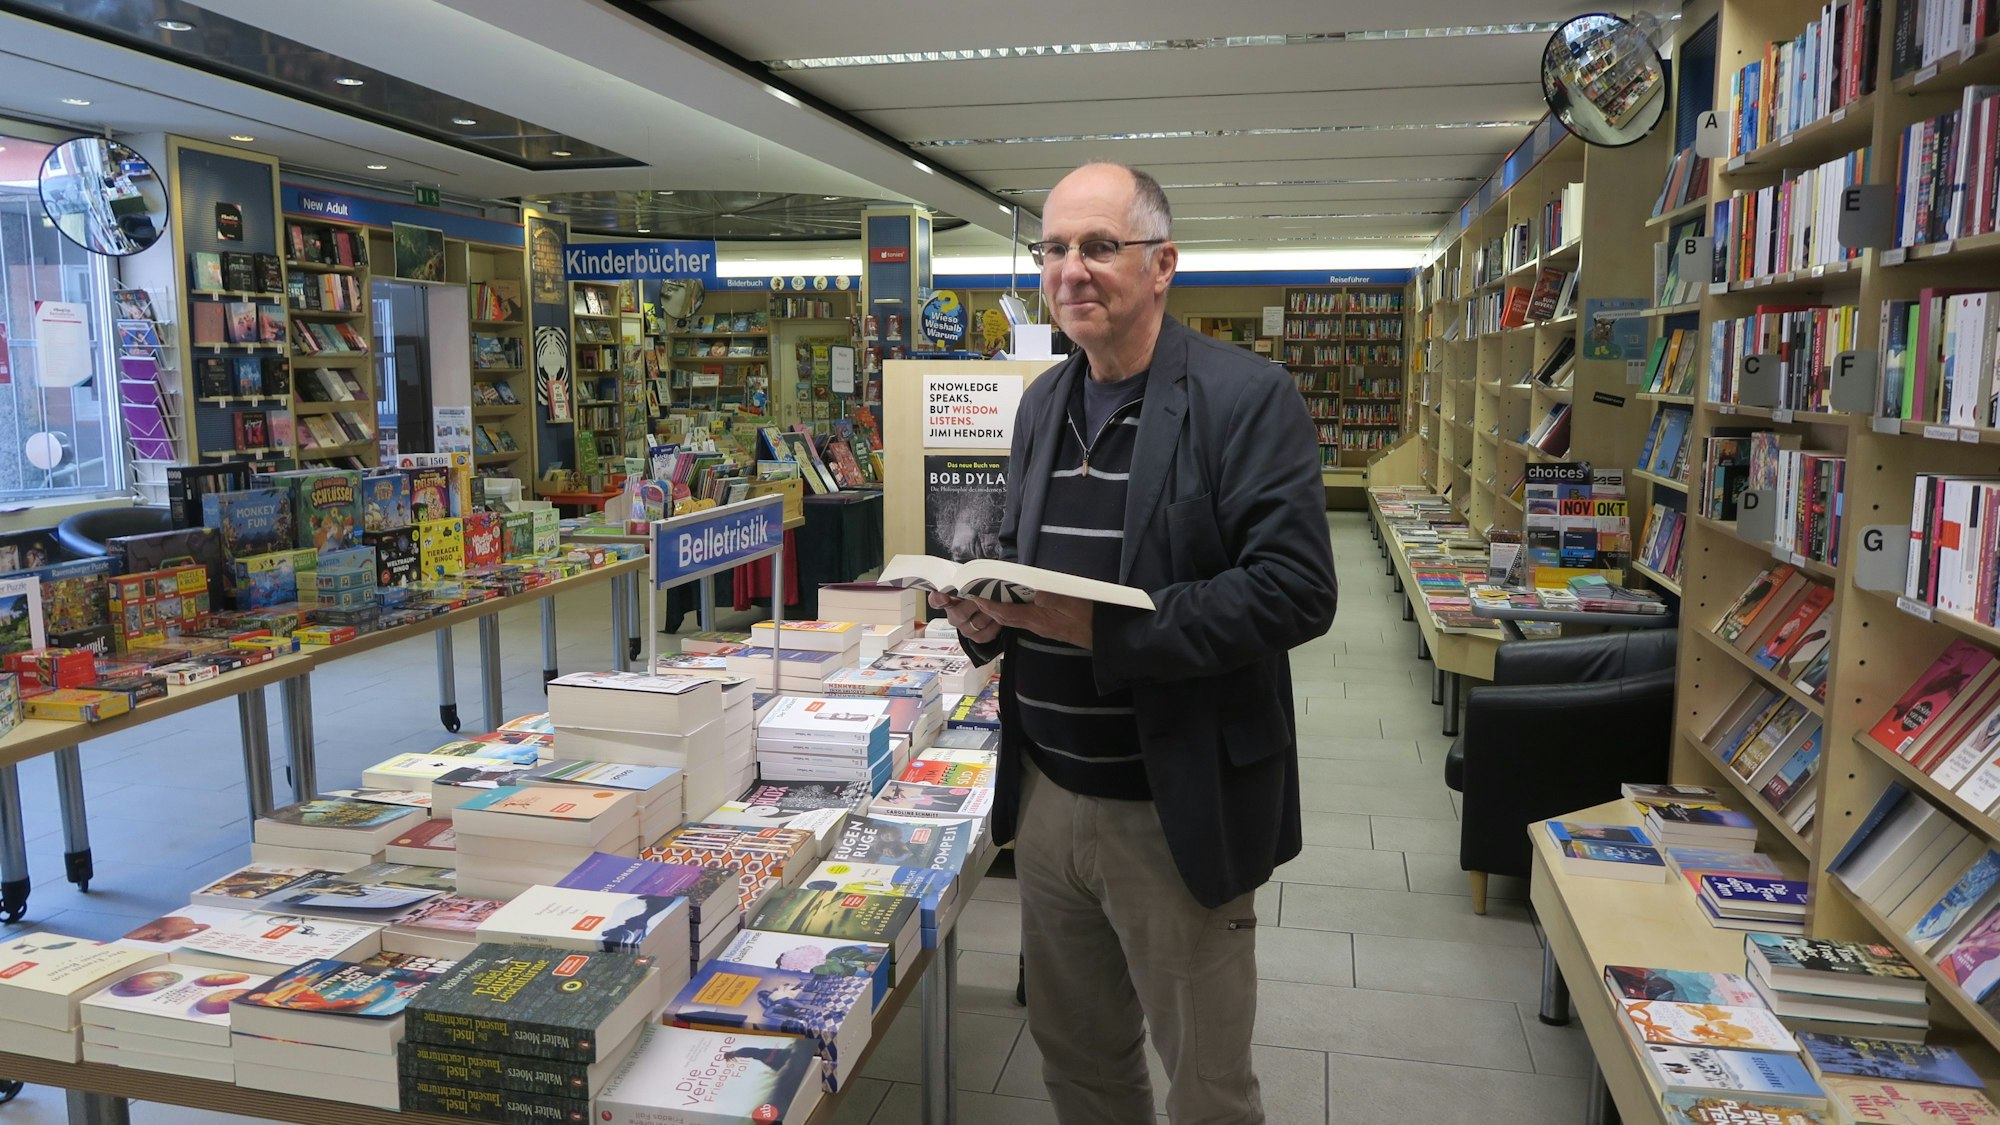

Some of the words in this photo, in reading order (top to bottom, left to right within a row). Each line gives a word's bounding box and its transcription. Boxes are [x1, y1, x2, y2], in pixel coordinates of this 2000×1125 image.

[1704, 113, 1718, 129] A
[303, 198, 324, 211] New
[326, 201, 349, 216] Adult
[1845, 190, 1861, 212] E
[1685, 240, 1697, 255] B
[566, 248, 711, 274] Kinderbücher
[727, 279, 763, 287] Bilderbuch
[1329, 275, 1370, 283] Reiseführer
[931, 311, 958, 323] Wieso
[925, 319, 962, 332] Weshalb
[926, 327, 959, 340] Warum
[1744, 357, 1760, 374] C
[1840, 355, 1855, 377] F
[930, 383, 999, 392] KNOWLEDGE
[929, 394, 972, 404] SPEAKS,
[930, 405, 950, 414] BUT
[952, 405, 998, 415] WISDOM
[929, 416, 974, 425] LISTENS.
[929, 428, 951, 437] JIMI
[954, 429, 1004, 438] HENDRIX
[929, 472, 960, 485] BOB
[1528, 466, 1584, 479] choices
[1564, 501, 1591, 515] NOV
[1597, 502, 1626, 516] OKT
[1743, 493, 1760, 510] D
[236, 505, 276, 518] MONKEY
[247, 519, 268, 529] FUN
[679, 514, 768, 568] Belletristik
[1863, 529, 1883, 552] G
[427, 545, 459, 558] TIERKACKE
[434, 554, 453, 563] BINGO
[52, 564, 90, 577] Ravensburger
[91, 561, 110, 571] Puzzle
[386, 557, 417, 568] WELTRAUM-
[393, 565, 410, 574] BINGO
[6, 583, 27, 592] Puzzle
[957, 769, 974, 785] SÜD
[754, 786, 789, 806] HLOX
[886, 809, 914, 817] CAROLINE
[834, 820, 865, 860] EUGEN
[852, 828, 878, 858] RUGE
[931, 826, 959, 870] POMPEJI
[600, 881, 616, 893] DIE
[615, 862, 643, 884] SOMMER
[1726, 877, 1745, 893] dem
[1714, 881, 1733, 897] Arm
[1740, 880, 1760, 894] mit
[1758, 887, 1778, 902] Frau
[1769, 883, 1789, 896] Die
[861, 903, 880, 926] GESANG
[874, 898, 903, 935] FLUSSKREBSE
[732, 941, 754, 963] Quality
[745, 931, 763, 948] Time
[438, 970, 468, 991] Walter
[464, 957, 487, 975] Moers
[472, 960, 532, 996] Tausend
[473, 968, 502, 987] Insel
[491, 959, 550, 1003] Leuchttürme
[424, 1012, 473, 1031] Leuchttürme
[475, 1019, 509, 1036] Tausend
[452, 1028, 475, 1044] Insel
[478, 1031, 488, 1041] Die
[514, 1030, 540, 1045] Moers
[542, 1031, 570, 1048] Walter
[634, 1026, 658, 1060] Minelli
[416, 1049, 467, 1068] Leuchttürme
[468, 1056, 502, 1073] Tausend
[446, 1065, 469, 1081] Insel
[471, 1069, 481, 1079] Die
[507, 1067, 533, 1082] Moers
[682, 1036, 736, 1106] Verlorene
[731, 1058, 750, 1078] Fall
[535, 1069, 563, 1086] Walter
[676, 1069, 702, 1092] Die
[704, 1061, 735, 1102] Friedas
[416, 1082, 466, 1102] Leuchttürme
[468, 1089, 502, 1107] Tausend
[446, 1098, 469, 1114] Insel
[470, 1103, 481, 1112] Die
[507, 1101, 533, 1116] Moers
[535, 1102, 562, 1119] Walter
[761, 1103, 772, 1118] atb
[1720, 1100, 1746, 1125] FLAM
